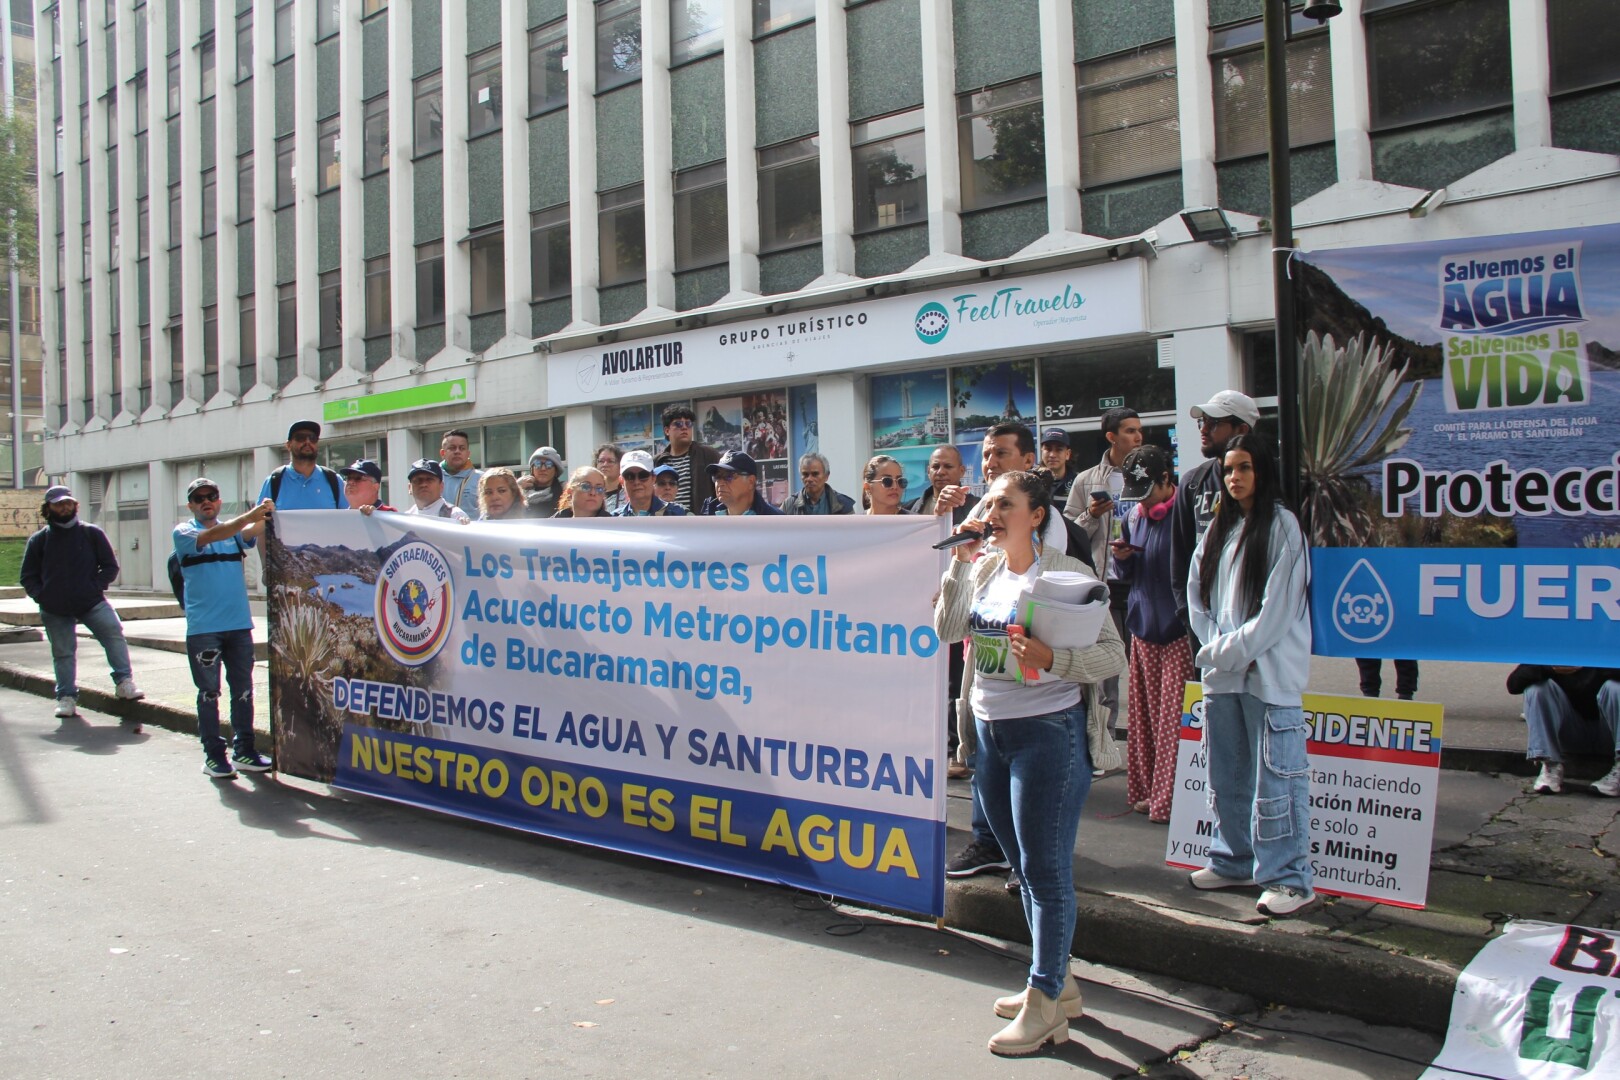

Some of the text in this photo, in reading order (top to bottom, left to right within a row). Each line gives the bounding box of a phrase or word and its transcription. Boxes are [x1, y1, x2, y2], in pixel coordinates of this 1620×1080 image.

[1443, 248, 1574, 282] Salvemos el
[1440, 271, 1583, 330] AGUA
[719, 312, 868, 346] GRUPO TURÍSTICO
[752, 340, 788, 350] AGENCIAS
[804, 334, 831, 342] VIAJES
[1447, 328, 1580, 358] Salvemos la
[601, 341, 683, 375] AVOLARTUR
[1448, 350, 1584, 411] VIDA
[1044, 404, 1074, 418] 8-37
[1104, 399, 1119, 407] 8-23
[1433, 416, 1598, 432] COMITÉ PARA LA DEFENSA DEL AGUA
[1447, 427, 1583, 441] Y EL PÁRAMO DE SANTURBÁN
[385, 547, 446, 582] SINTRAEMSDES
[464, 546, 828, 594] Los Trabajadores del
[1418, 563, 1620, 621] FUER
[392, 621, 432, 643] BUCARAMANGA
[462, 589, 939, 658] Acueducto Metropolitano
[461, 633, 752, 704] de Bucaramanga,
[1188, 700, 1203, 729] S
[333, 677, 934, 799] DEFENDEMOS EL AGUA Y SANTURBAN
[1309, 768, 1337, 785] tan
[1342, 770, 1421, 795] haciendo
[351, 733, 920, 879] NUESTRO ORO ES EL AGUA
[1357, 797, 1422, 821] Minera
[1310, 817, 1377, 838] e solo a
[1195, 820, 1398, 870] M s Mining
[1171, 841, 1401, 891] y que Santurbán.
[1550, 925, 1620, 977] B
